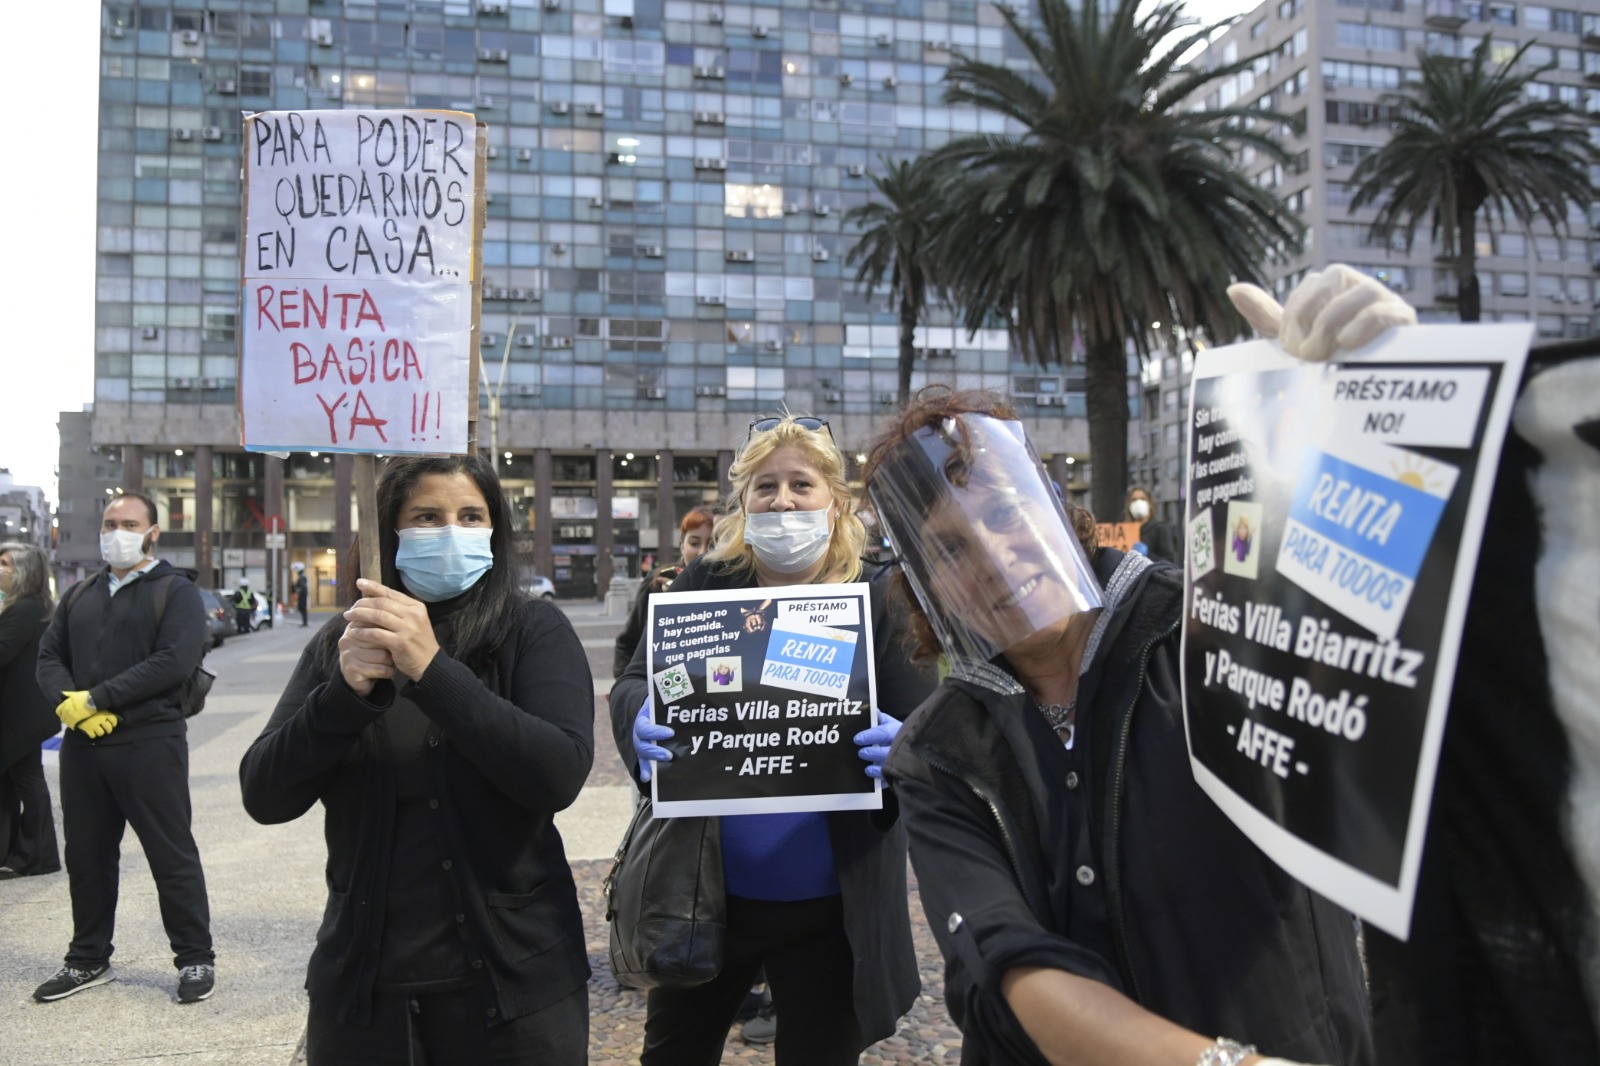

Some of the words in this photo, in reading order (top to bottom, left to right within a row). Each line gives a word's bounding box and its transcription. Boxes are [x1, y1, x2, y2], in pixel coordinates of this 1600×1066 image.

[255, 112, 332, 166] PARA
[357, 115, 468, 176] PODER
[276, 170, 465, 227] QUEDARNOS
[257, 226, 295, 271] EN
[256, 284, 385, 332] RENTA
[1335, 375, 1458, 401] PRÉSTAMO
[316, 390, 388, 444] YA
[411, 391, 441, 442] !!!
[1195, 408, 1210, 428] Sin
[1363, 412, 1406, 434] NO!
[1198, 433, 1215, 454] hay
[1196, 460, 1208, 479] las
[1209, 451, 1247, 475] cuentas
[1197, 488, 1212, 508] que
[1212, 475, 1254, 505] pagarlas
[1308, 473, 1403, 547] RENTA
[1282, 527, 1326, 572] PARA
[1330, 554, 1404, 611] TODOS
[658, 617, 674, 627] Sin
[677, 611, 713, 624] trabajo
[714, 609, 728, 618] no
[788, 602, 848, 612] PRÉSTAMO
[808, 614, 829, 623] NO!
[653, 642, 660, 652] Y
[661, 641, 677, 650] las
[679, 634, 720, 647] cuentas
[721, 630, 740, 641] hay
[663, 627, 683, 638] hay
[684, 620, 725, 634] comida.
[1191, 586, 1240, 634] Ferias
[1244, 601, 1293, 652] Villa
[1294, 616, 1424, 688] Biarritz
[665, 653, 685, 665] que
[686, 644, 731, 661] pagarlas
[780, 639, 838, 664] RENTA
[765, 663, 801, 682] PARA
[803, 668, 846, 689] TODOS
[1203, 651, 1217, 687] y
[1216, 649, 1286, 710] Parque
[1287, 676, 1370, 741] Rodó
[666, 703, 729, 724] Ferias
[735, 700, 780, 721] Villa
[785, 698, 862, 719] Biarritz
[690, 735, 704, 755] y
[708, 730, 781, 751] Parque
[786, 725, 840, 746] Rodó
[1236, 718, 1295, 778] AFFE
[739, 755, 794, 776] AFFE
